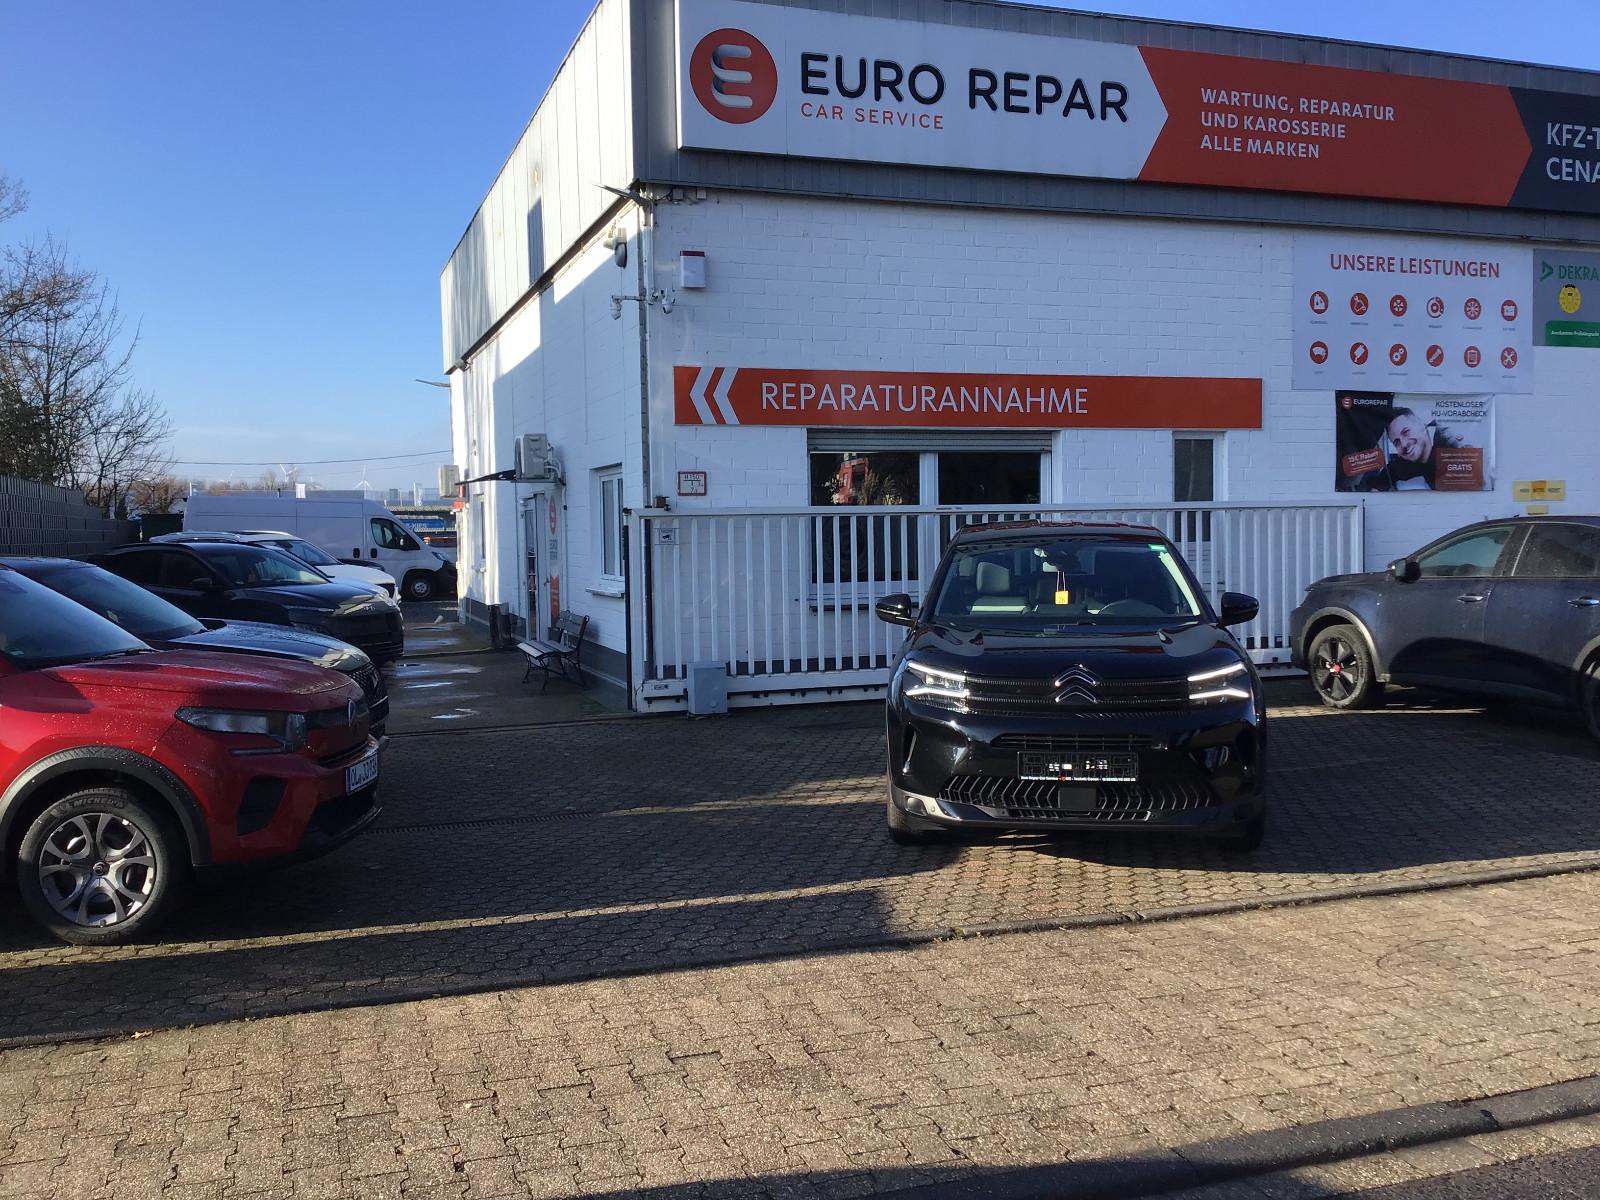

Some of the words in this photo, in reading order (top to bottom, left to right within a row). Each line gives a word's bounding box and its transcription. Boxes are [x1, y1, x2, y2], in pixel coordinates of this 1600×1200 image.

[800, 51, 946, 106] EURO
[968, 67, 1129, 123] REPAR
[800, 103, 844, 121] CAR
[853, 107, 944, 130] SERVICE
[1200, 87, 1295, 113] WARTUNG,
[1299, 97, 1395, 121] REPARATUR
[1201, 111, 1239, 129] UND
[1243, 115, 1346, 139] KAROSSERIE
[1200, 134, 1242, 152] ALLE
[1246, 138, 1320, 158] MARKEN
[1330, 253, 1396, 273] UNSERE
[1399, 256, 1501, 278] LEISTUNGEN
[1558, 264, 1600, 281] DEKRA
[762, 382, 1088, 414] REPARATURANNAHME
[1431, 409, 1488, 417] HU-VORABCHECK
[1447, 464, 1473, 472] GRATIS
